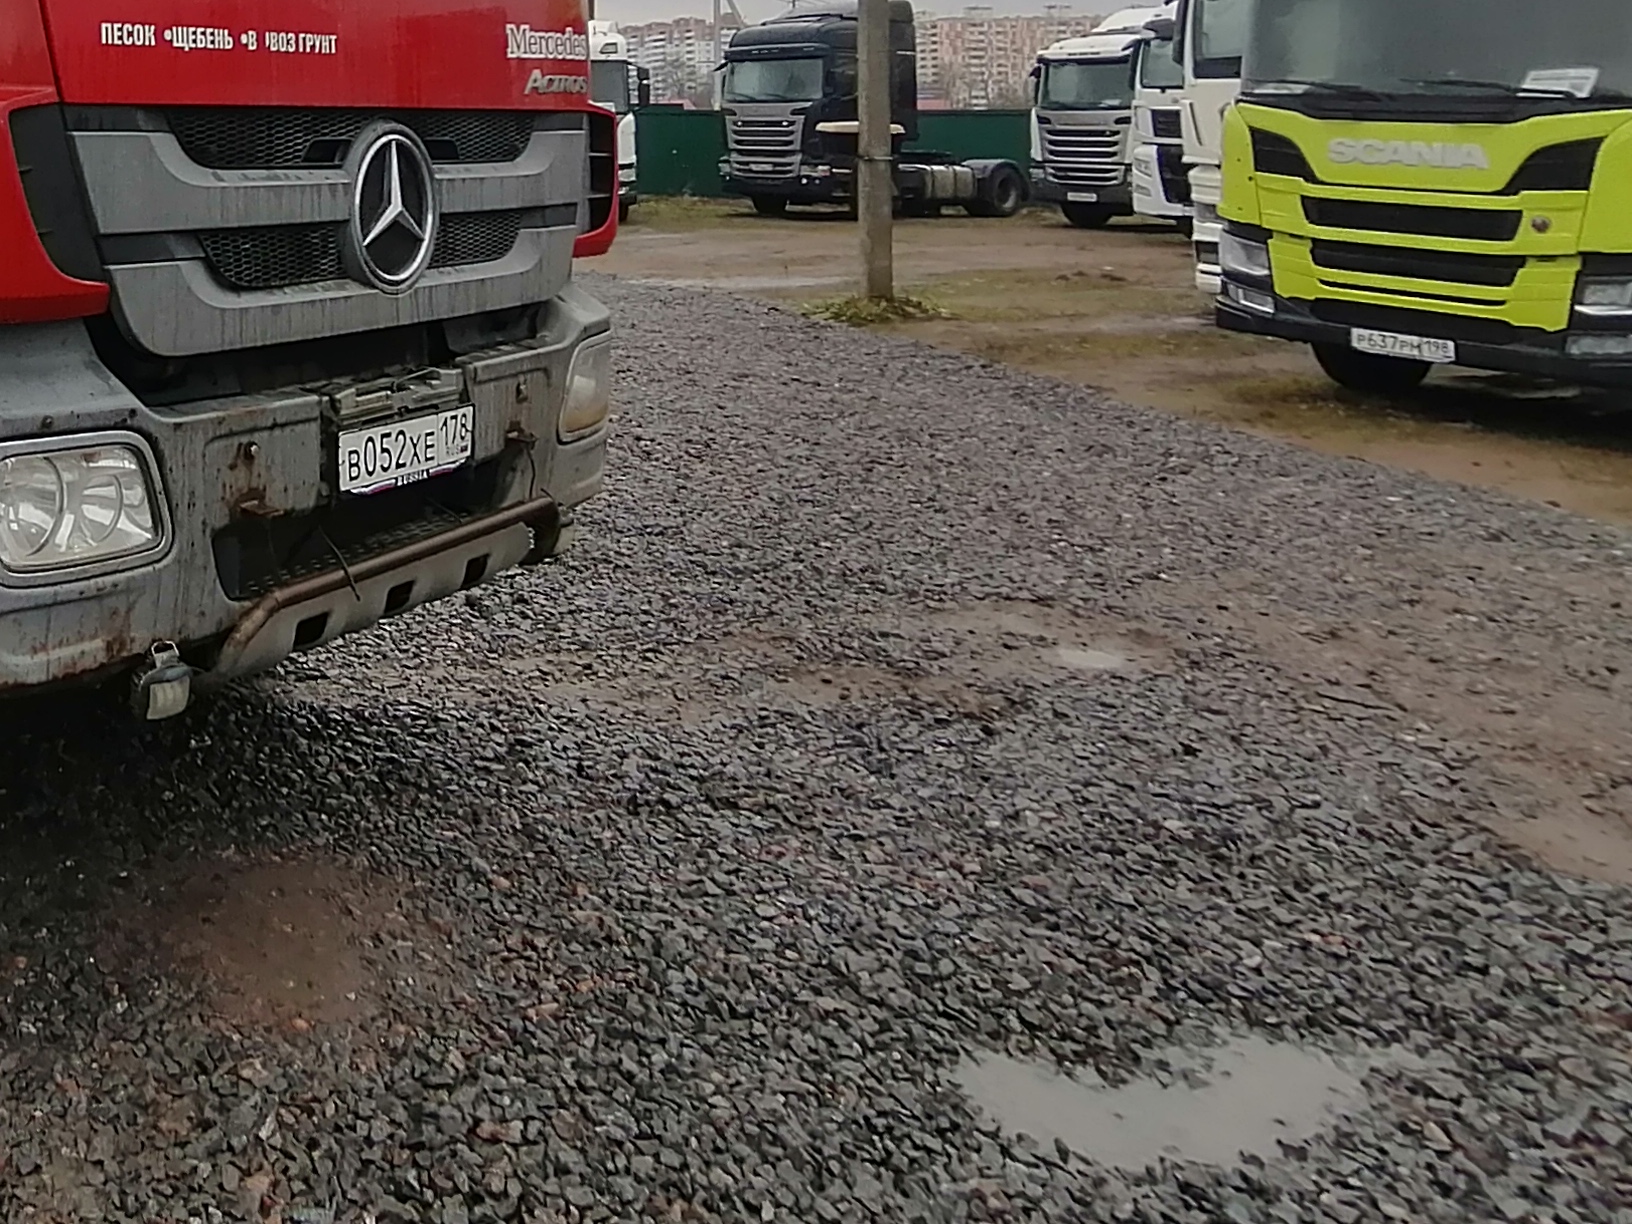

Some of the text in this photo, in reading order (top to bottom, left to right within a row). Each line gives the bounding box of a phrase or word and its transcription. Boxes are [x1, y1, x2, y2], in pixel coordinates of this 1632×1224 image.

[100, 22, 156, 46] ПЕСОК
[171, 26, 234, 51] ЩЕБЕНЬ
[298, 33, 337, 54] ГРУНТ
[505, 23, 588, 61] Mercedes
[1328, 137, 1490, 169] SCANIA
[348, 412, 468, 481] В052ХЕ 178
